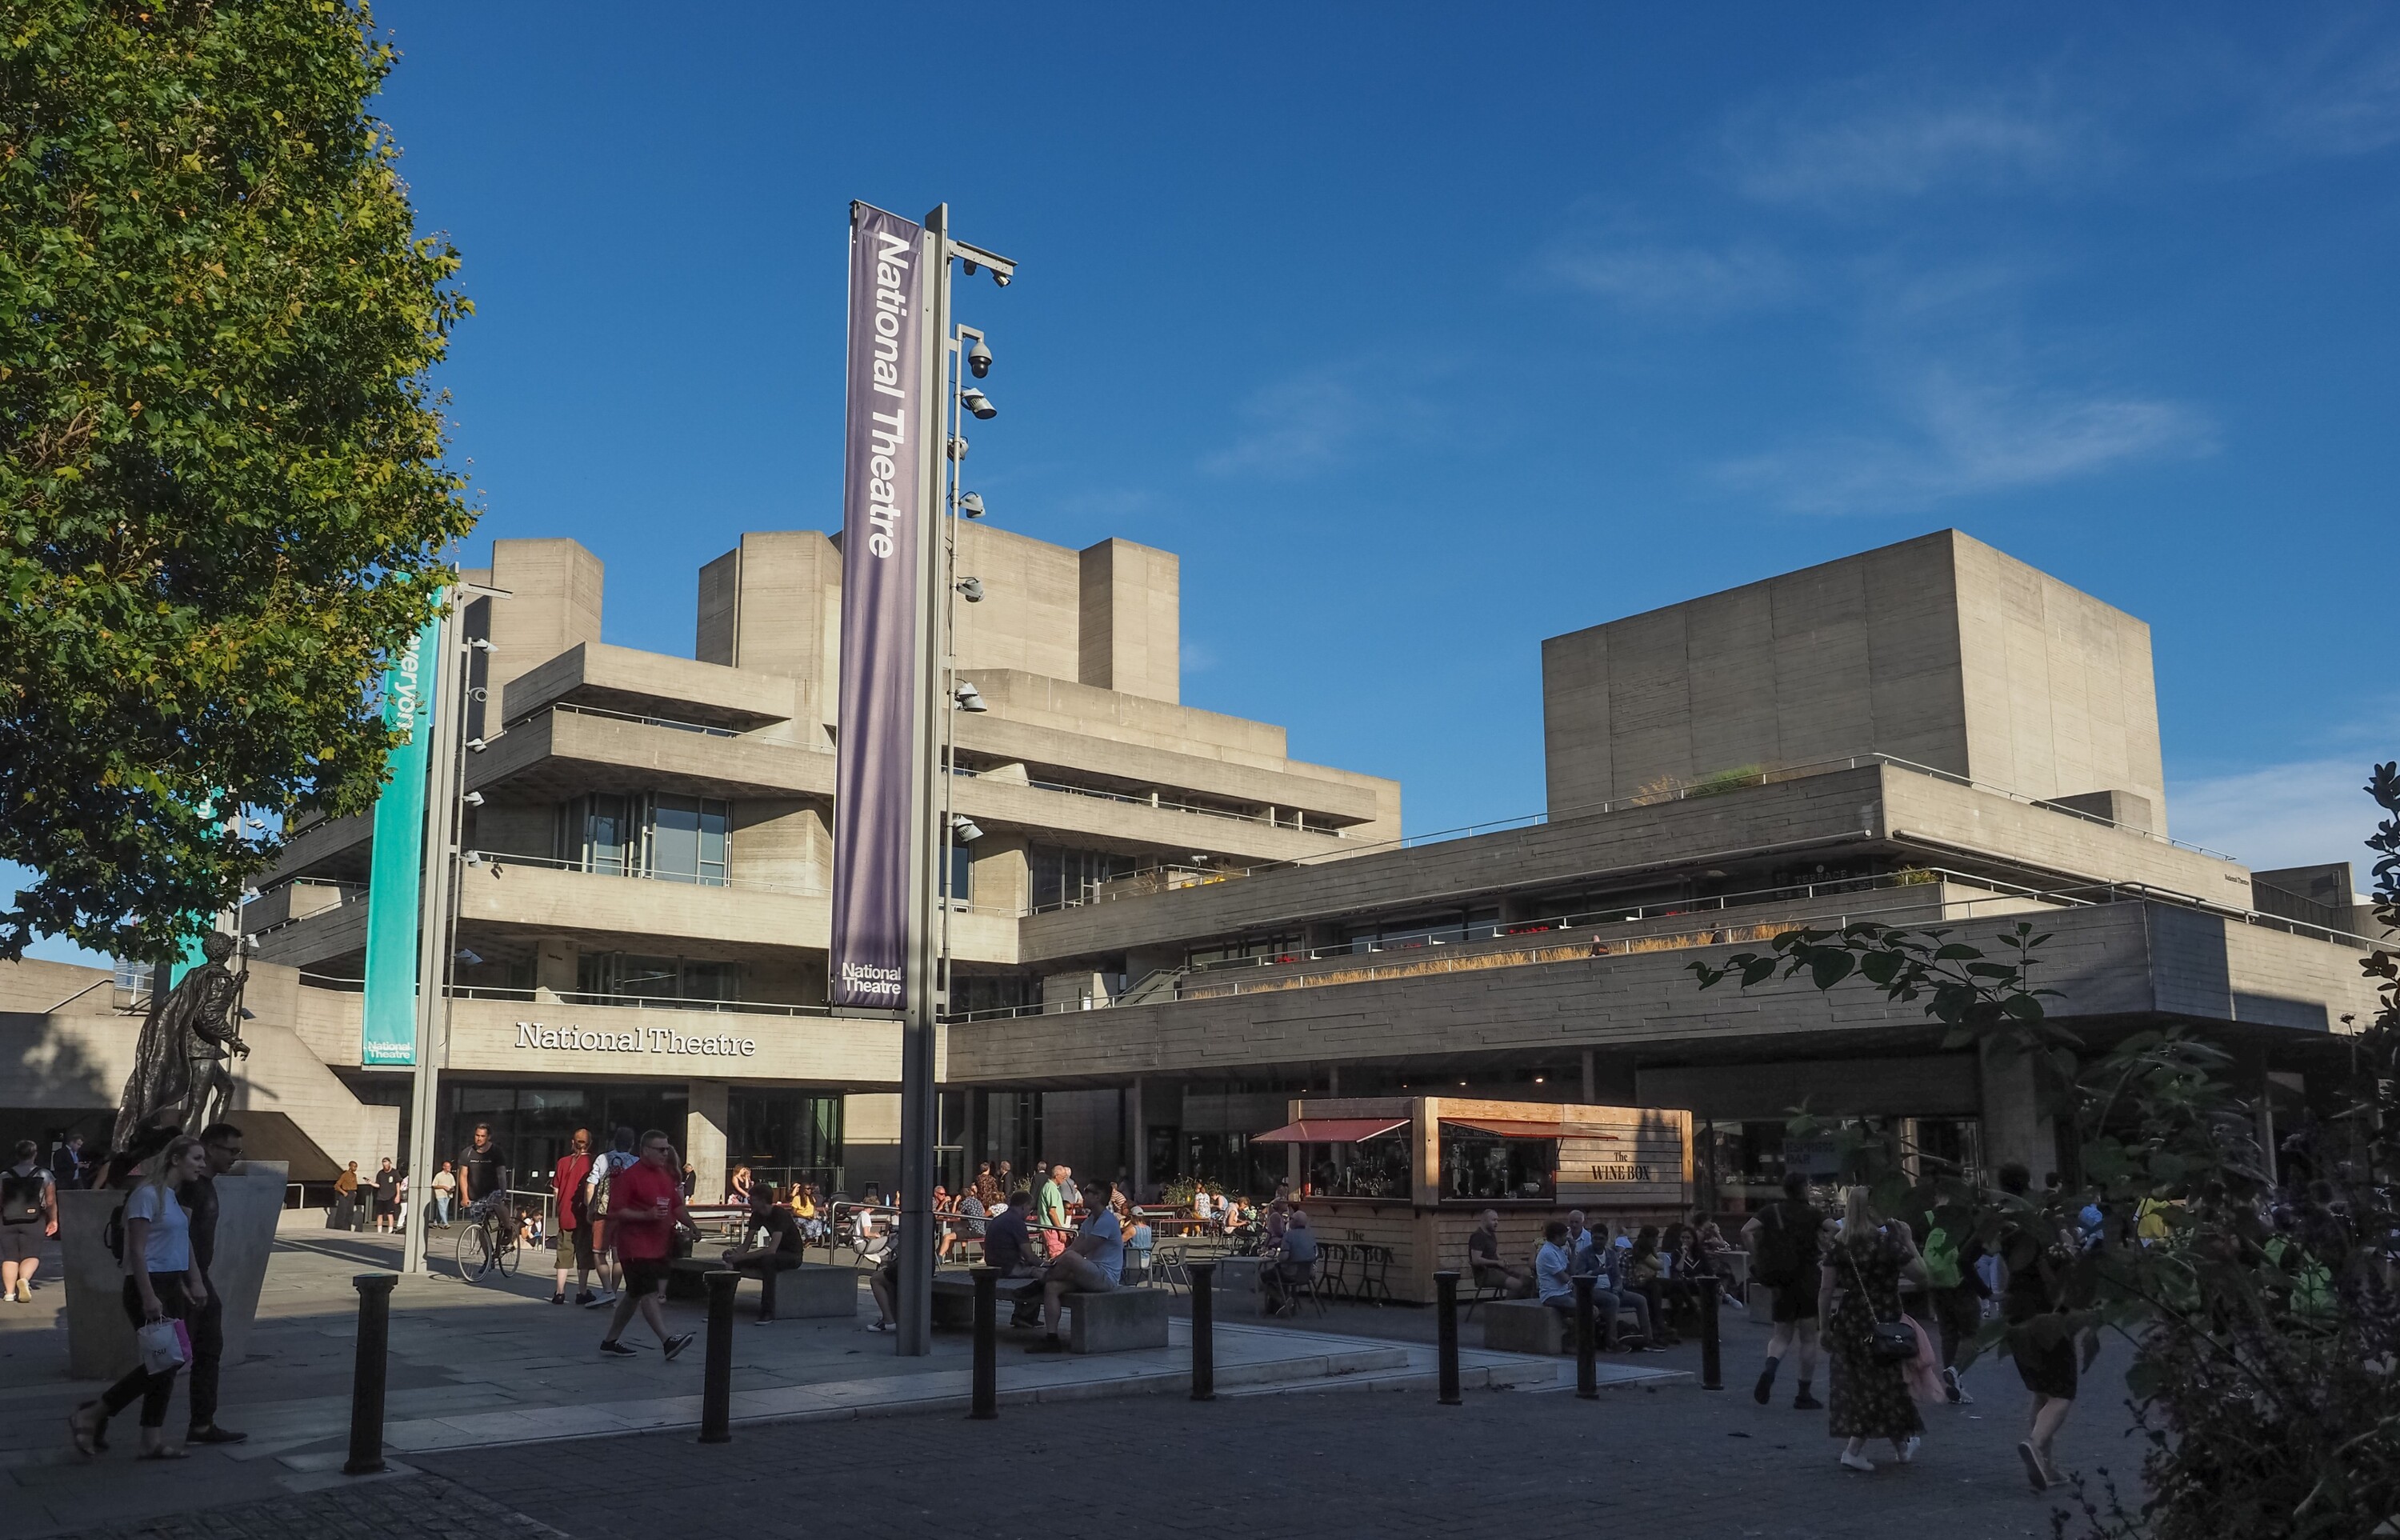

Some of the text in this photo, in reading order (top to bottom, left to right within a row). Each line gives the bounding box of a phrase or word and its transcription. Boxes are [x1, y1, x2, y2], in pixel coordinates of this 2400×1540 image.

[869, 231, 910, 558] National Theatre
[842, 962, 901, 981] National
[842, 977, 902, 995] Theatre
[368, 1041, 410, 1051] National
[515, 1022, 756, 1057] National Theatre
[369, 1050, 411, 1058] Theatre
[1614, 1151, 1628, 1162] The
[1591, 1165, 1650, 1180] WINE BOX
[1346, 1229, 1365, 1241] The
